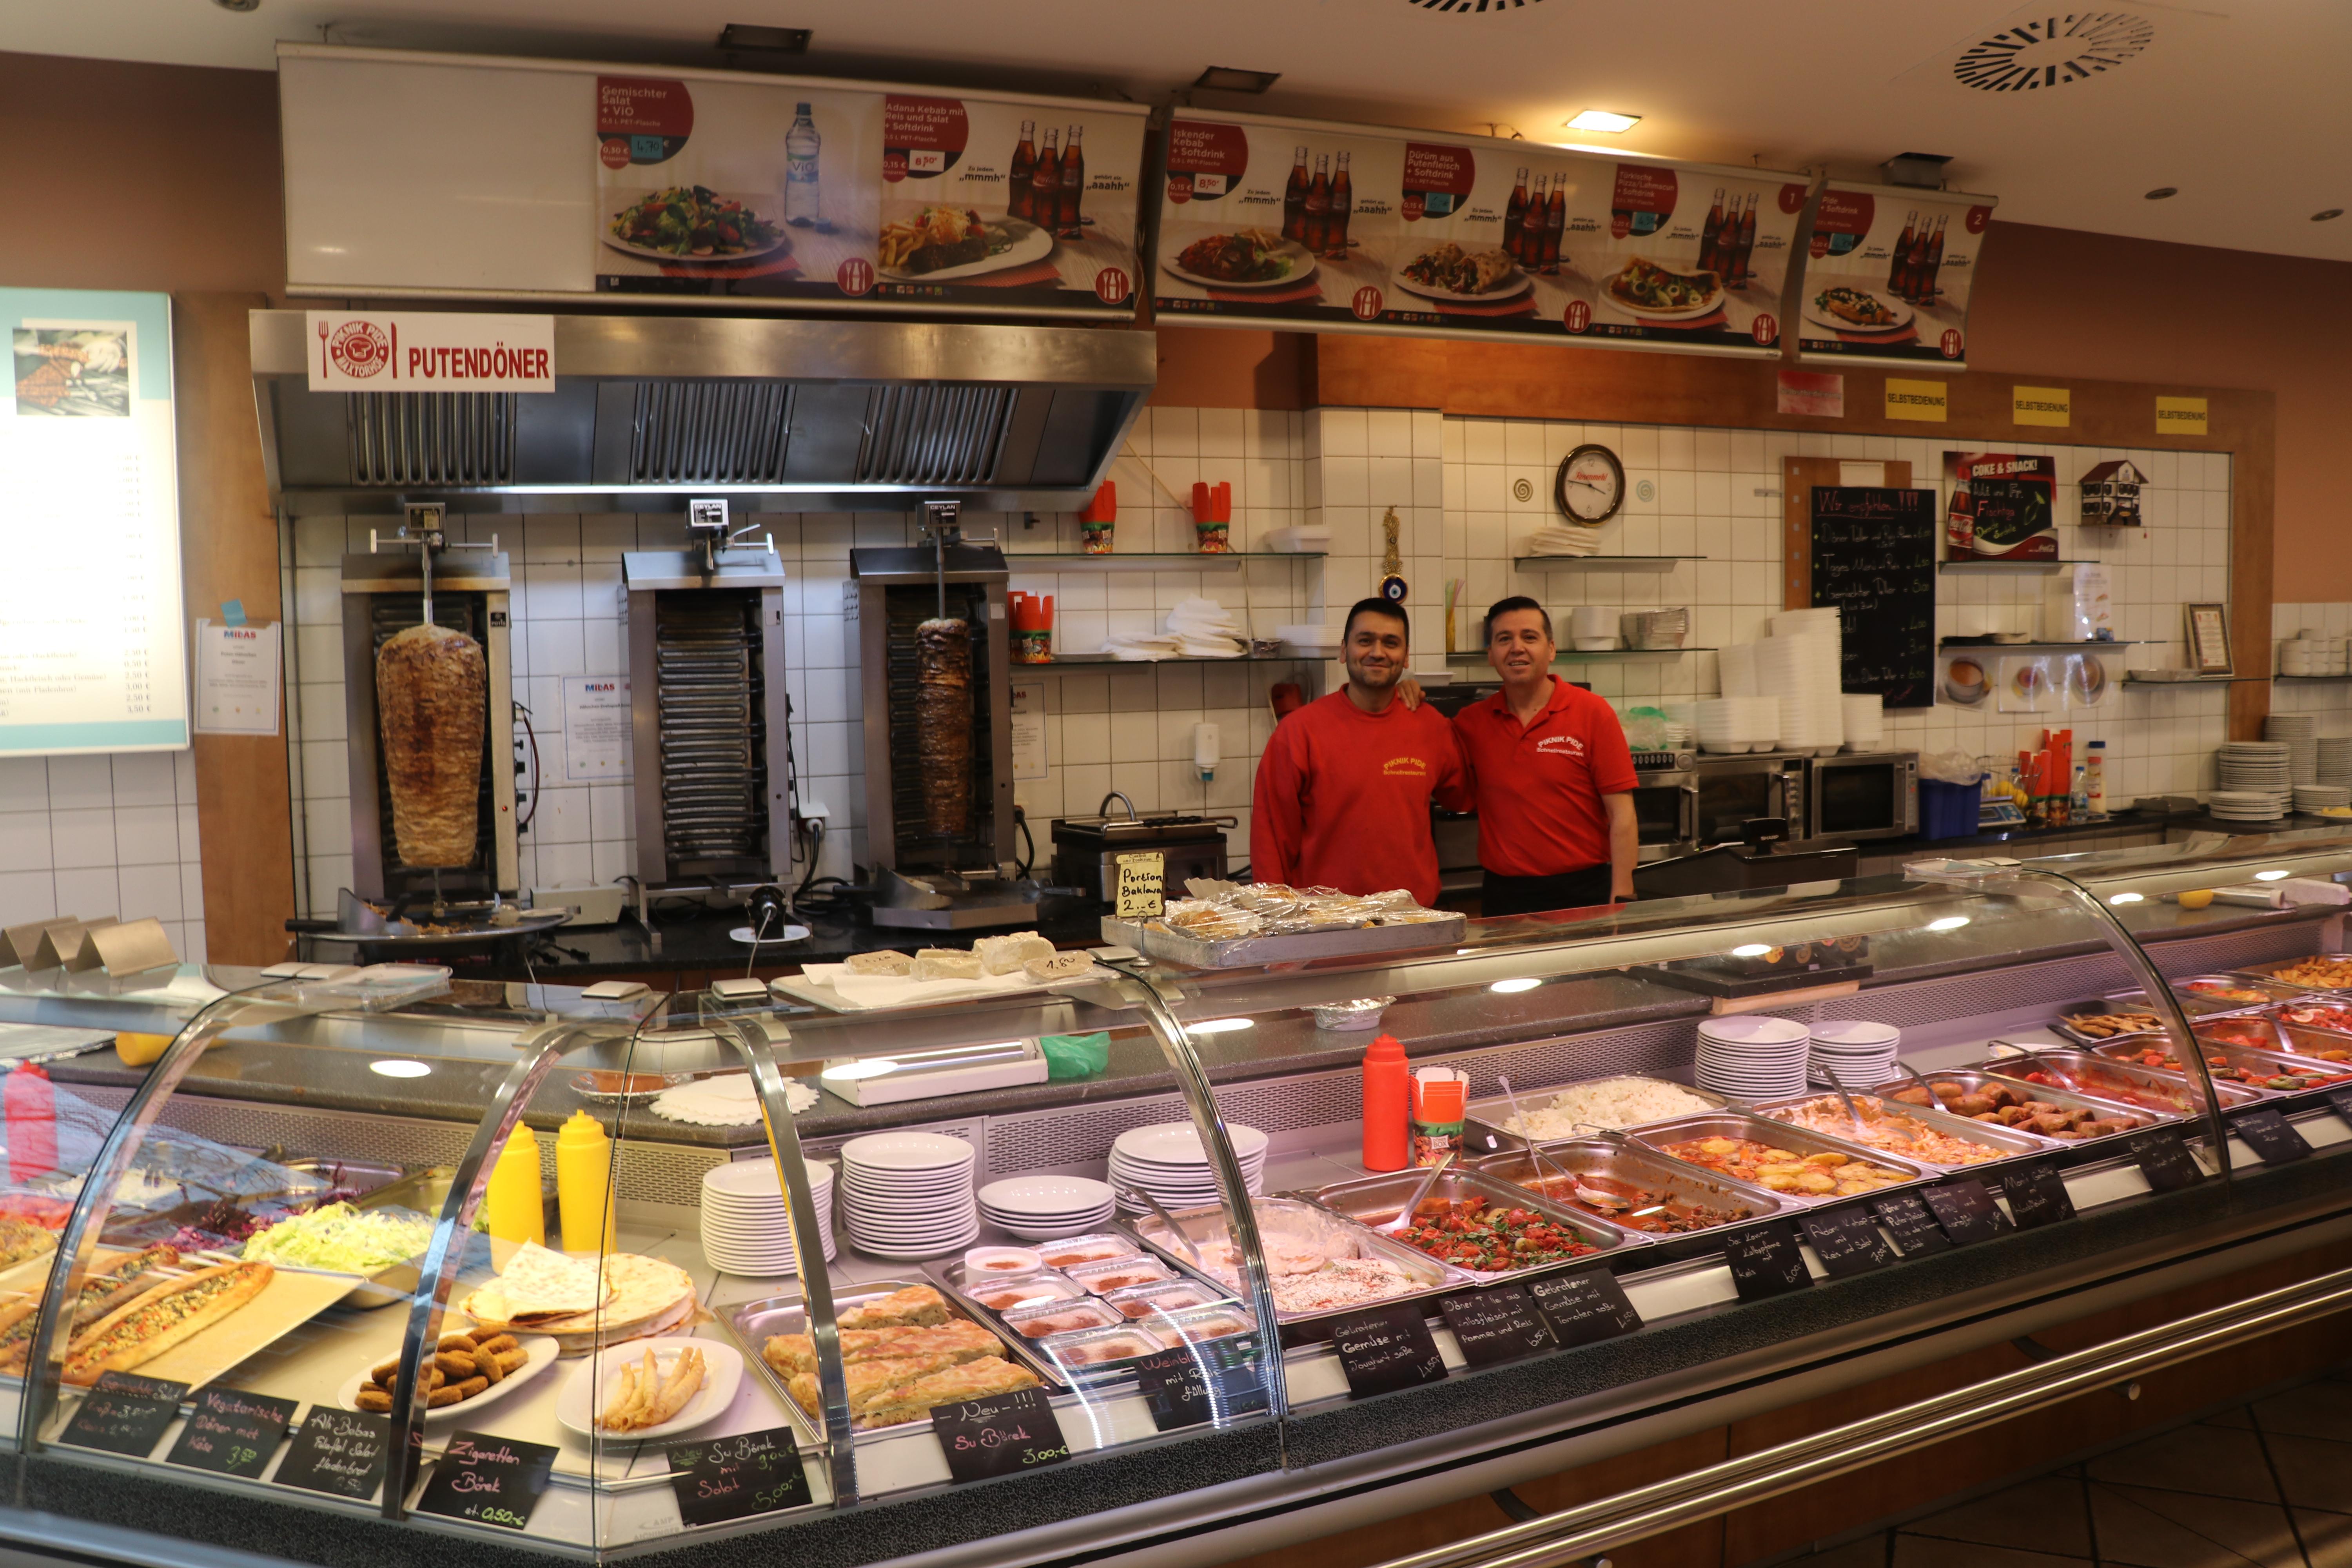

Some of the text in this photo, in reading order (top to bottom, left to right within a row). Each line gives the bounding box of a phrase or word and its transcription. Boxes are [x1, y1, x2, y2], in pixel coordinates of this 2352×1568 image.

[602, 85, 667, 98] Gemischter
[602, 95, 630, 105] Salat
[886, 103, 915, 113] Adana
[918, 105, 946, 114] Kebab
[926, 115, 949, 123] Salat
[893, 122, 935, 132] Softdrink
[1173, 138, 1204, 147] Kebab
[1181, 148, 1226, 159] Softdrink
[1409, 151, 1437, 160] Dürüm
[1408, 159, 1460, 171] Putenfleisch
[1414, 168, 1454, 179] Softdrink
[1975, 214, 1982, 225] 2
[332, 322, 388, 348] PIKNIK PIDE
[409, 341, 550, 379] PUTENDÖNER
[1887, 393, 1945, 407] SELBSTBEDIENUNG
[2015, 400, 2068, 413] SELBSTBEDIENUNG
[2158, 410, 2206, 421] SELBSTBEDIENUNG
[1587, 459, 1595, 467] 12
[1972, 459, 2038, 477] COKE & SNACK!
[1607, 483, 1612, 491] 3
[1586, 504, 1592, 513] 6
[1537, 736, 1584, 751] PIKNIK PIDE
[1384, 757, 1426, 770] PIKNIK PIDE
[1123, 869, 1162, 883] Portion
[1444, 1292, 1521, 1312] Döner aus
[1544, 1290, 1601, 1311] Gemüse mit
[1510, 1305, 1524, 1316] mit
[1553, 1309, 1594, 1325] Tomaten
[1461, 1318, 1534, 1344] Pommes und Reis
[1342, 1328, 1411, 1354] Gemüse mit
[1165, 1372, 1184, 1386] mit
[310, 1412, 377, 1439] Ali Babas
[236, 1425, 259, 1441] mit
[189, 1435, 214, 1452] Käse
[313, 1435, 381, 1459] Falafel Salat
[708, 1442, 731, 1464] Su
[735, 1435, 775, 1460] Börek
[955, 1435, 976, 1450] Su
[448, 1441, 520, 1466] Zigaretten
[720, 1463, 740, 1475] mit
[451, 1471, 501, 1493] Börek
[697, 1477, 740, 1498] Salat
